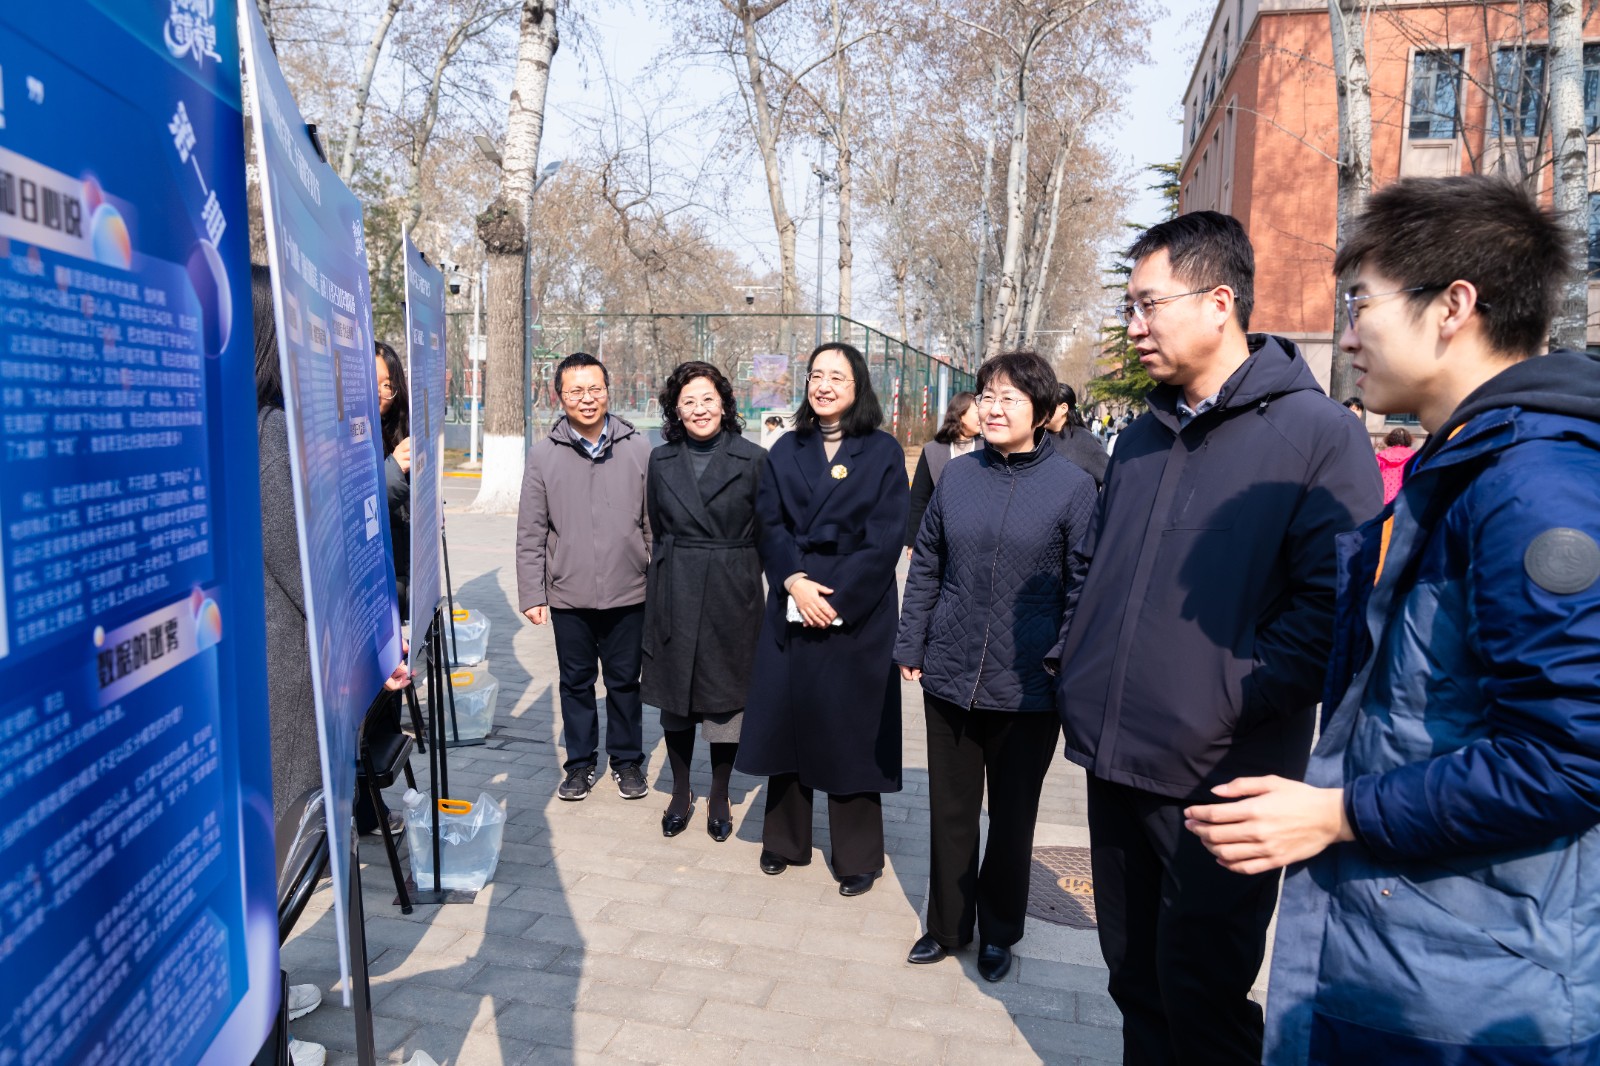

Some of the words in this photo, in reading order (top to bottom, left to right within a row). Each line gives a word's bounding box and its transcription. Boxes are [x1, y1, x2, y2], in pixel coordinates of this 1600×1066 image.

[97, 617, 180, 690] 数据的迷雾
